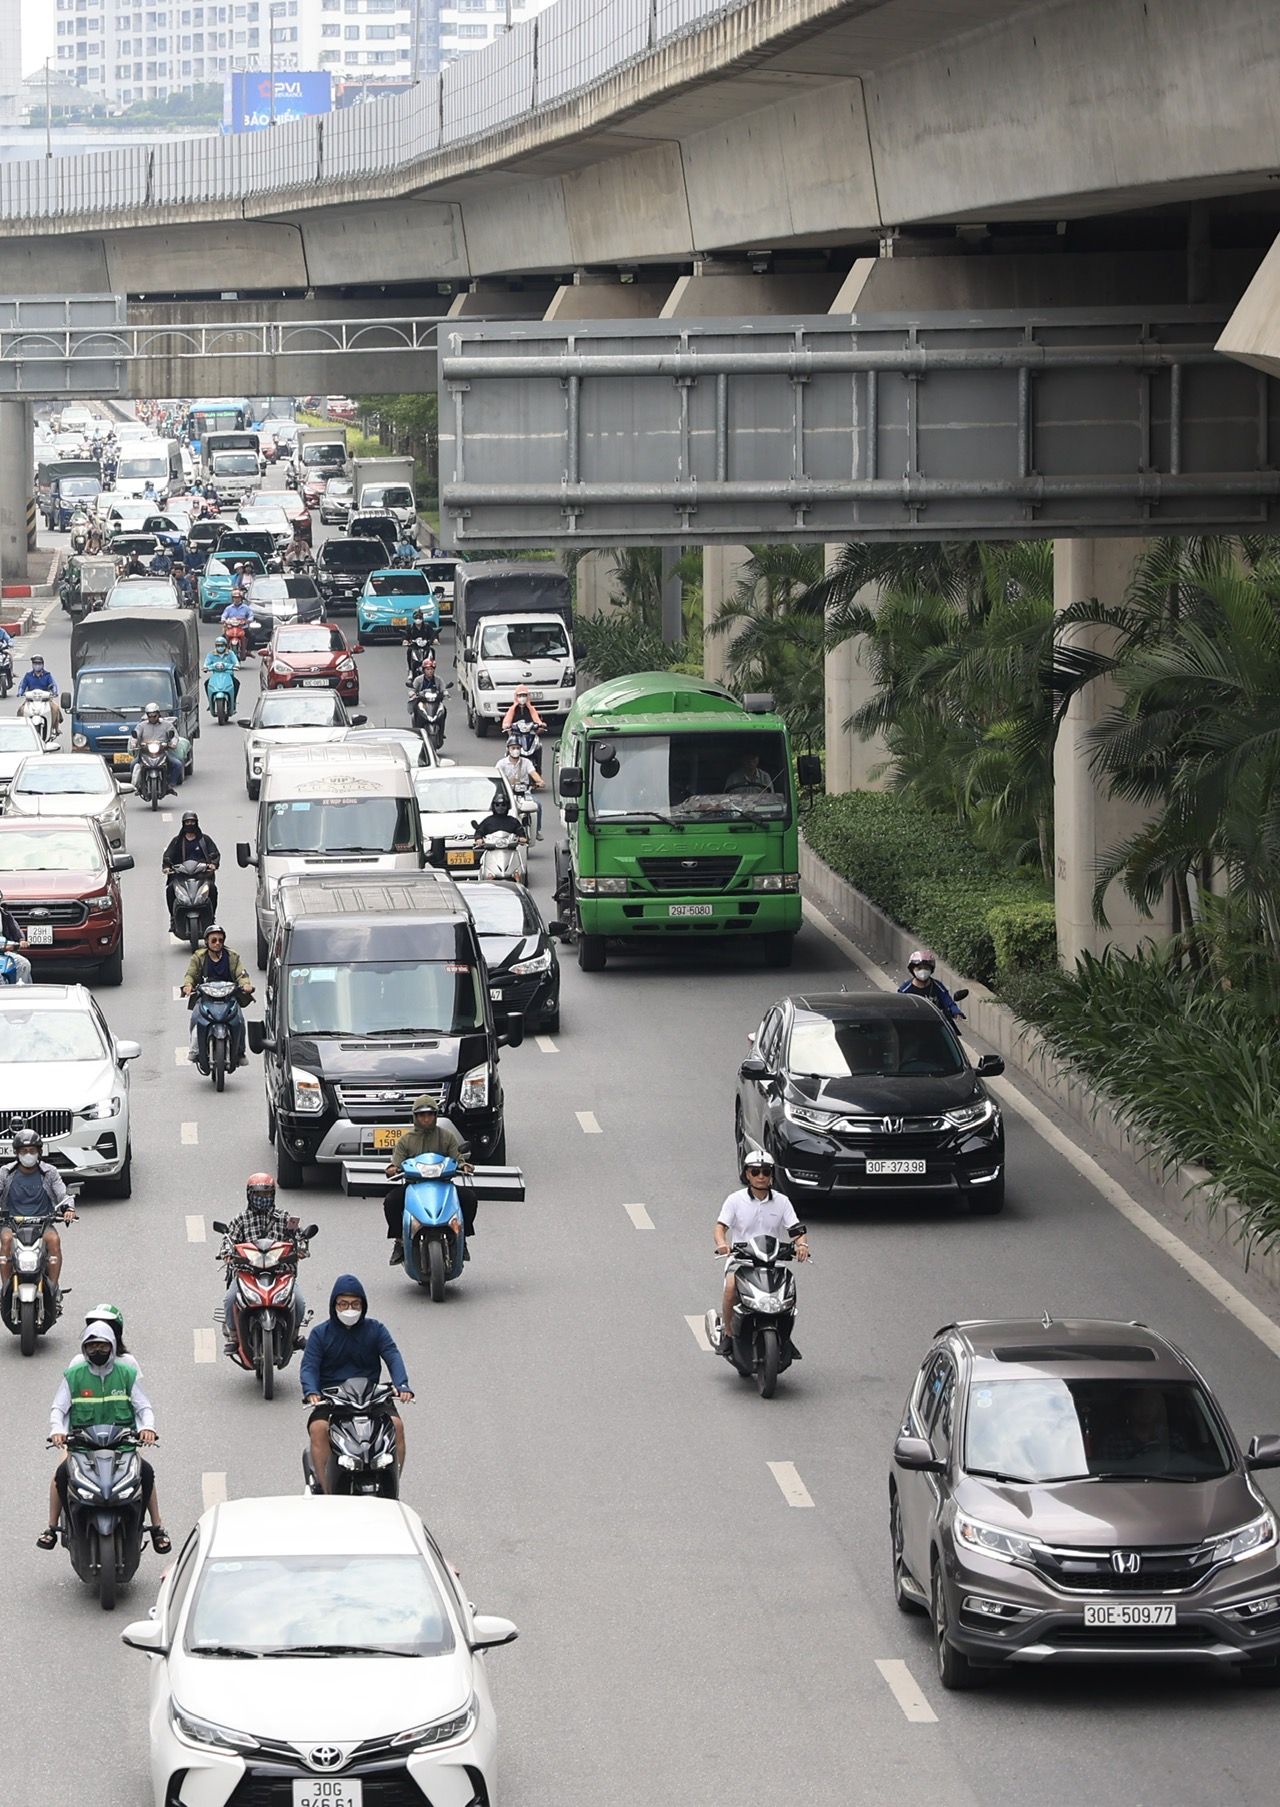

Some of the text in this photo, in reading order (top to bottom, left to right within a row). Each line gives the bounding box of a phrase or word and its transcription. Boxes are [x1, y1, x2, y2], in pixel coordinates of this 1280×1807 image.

[275, 83, 300, 92] PVI
[641, 841, 738, 852] DAEWOO
[33, 928, 47, 936] 29H
[385, 1131, 402, 1139] 29B
[867, 1162, 924, 1172] 30F-373.98
[1087, 1607, 1173, 1624] 30E-509.77
[313, 1783, 341, 1796] 30G
